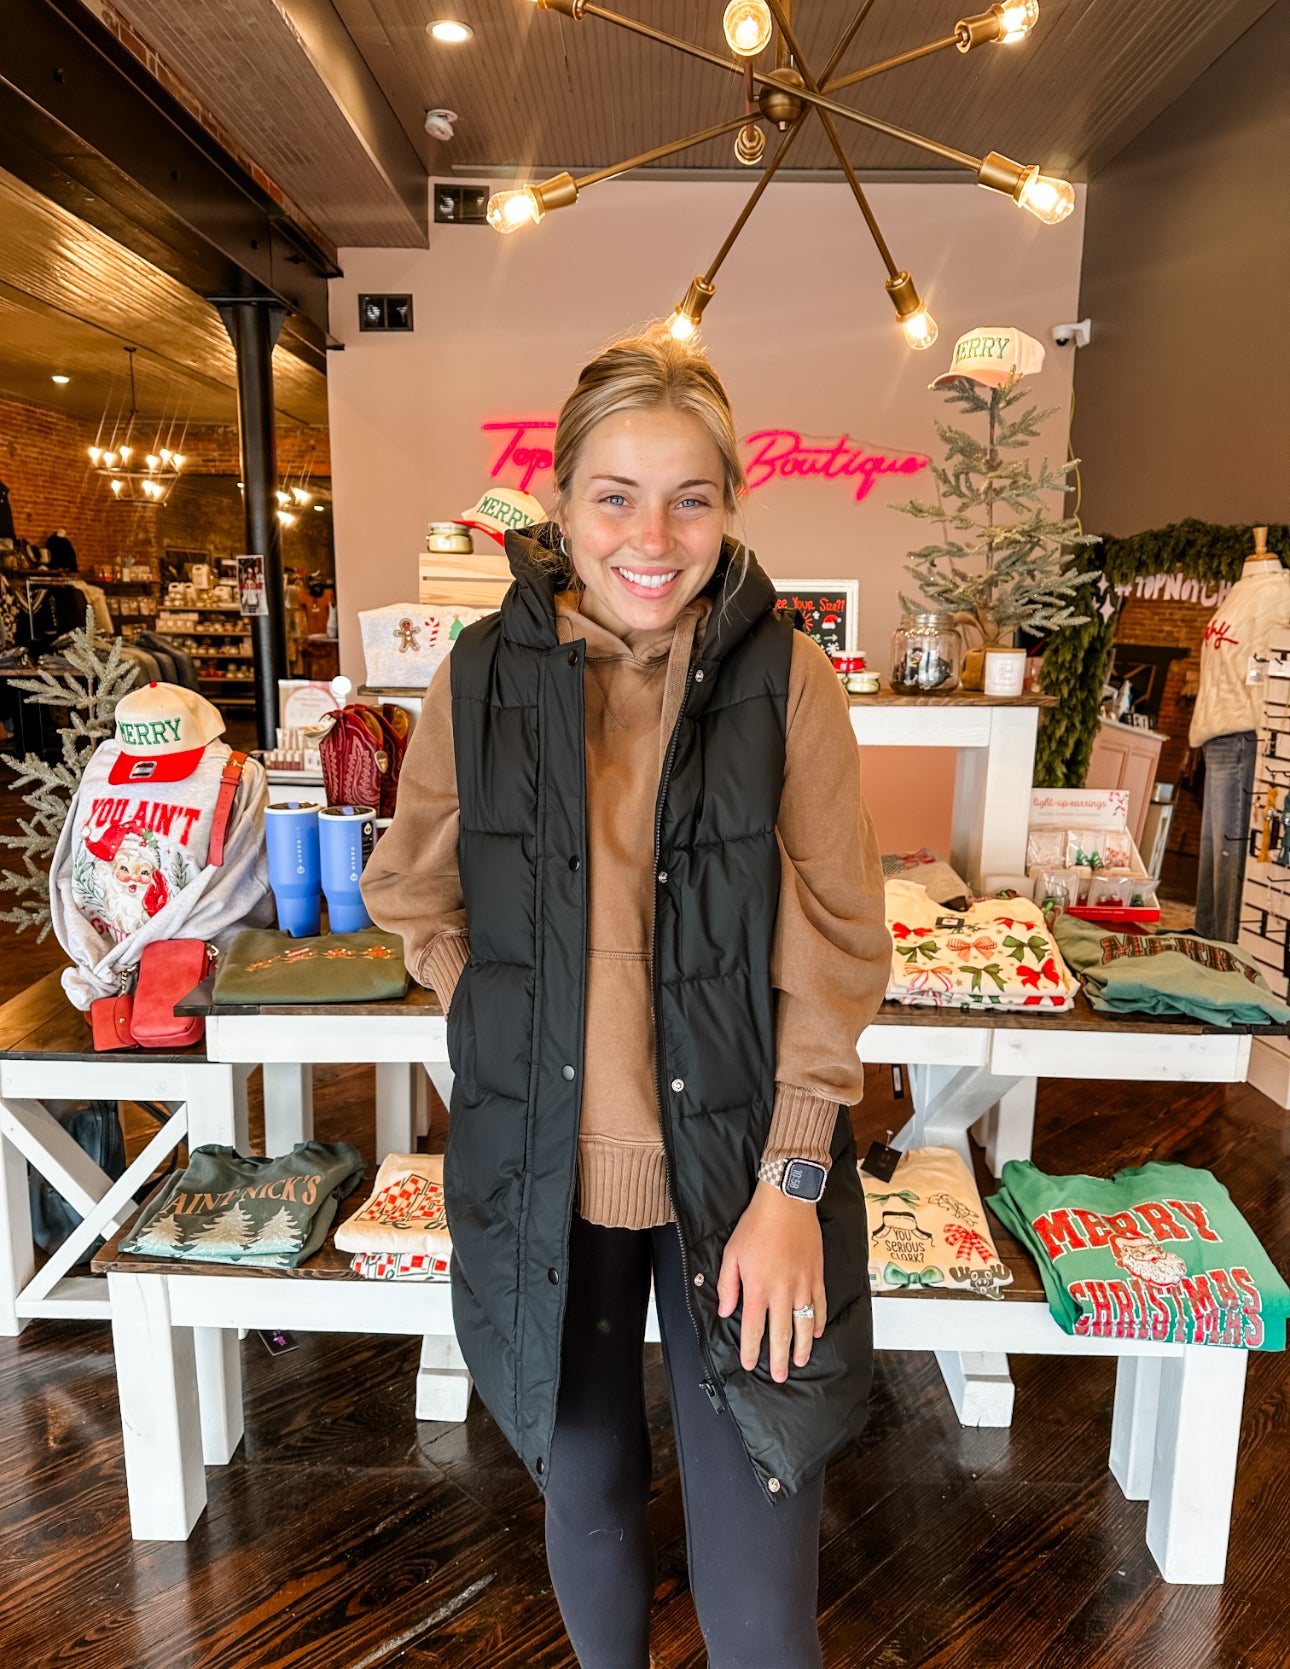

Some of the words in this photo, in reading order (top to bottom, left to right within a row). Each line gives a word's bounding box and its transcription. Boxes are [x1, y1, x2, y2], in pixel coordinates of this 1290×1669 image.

[955, 337, 1010, 365] ERRY
[481, 421, 557, 492] Top
[744, 429, 931, 502] Boutique
[85, 798, 131, 828] YOU
[132, 801, 202, 847] AIN'T
[158, 1192, 240, 1215] AINT
[240, 1174, 322, 1206] NICK'S
[892, 1227, 912, 1241] YOU
[1032, 1199, 1223, 1264] MERRY
[890, 1252, 925, 1264] CLARK?
[1067, 1266, 1264, 1341] CHRISTMAS
